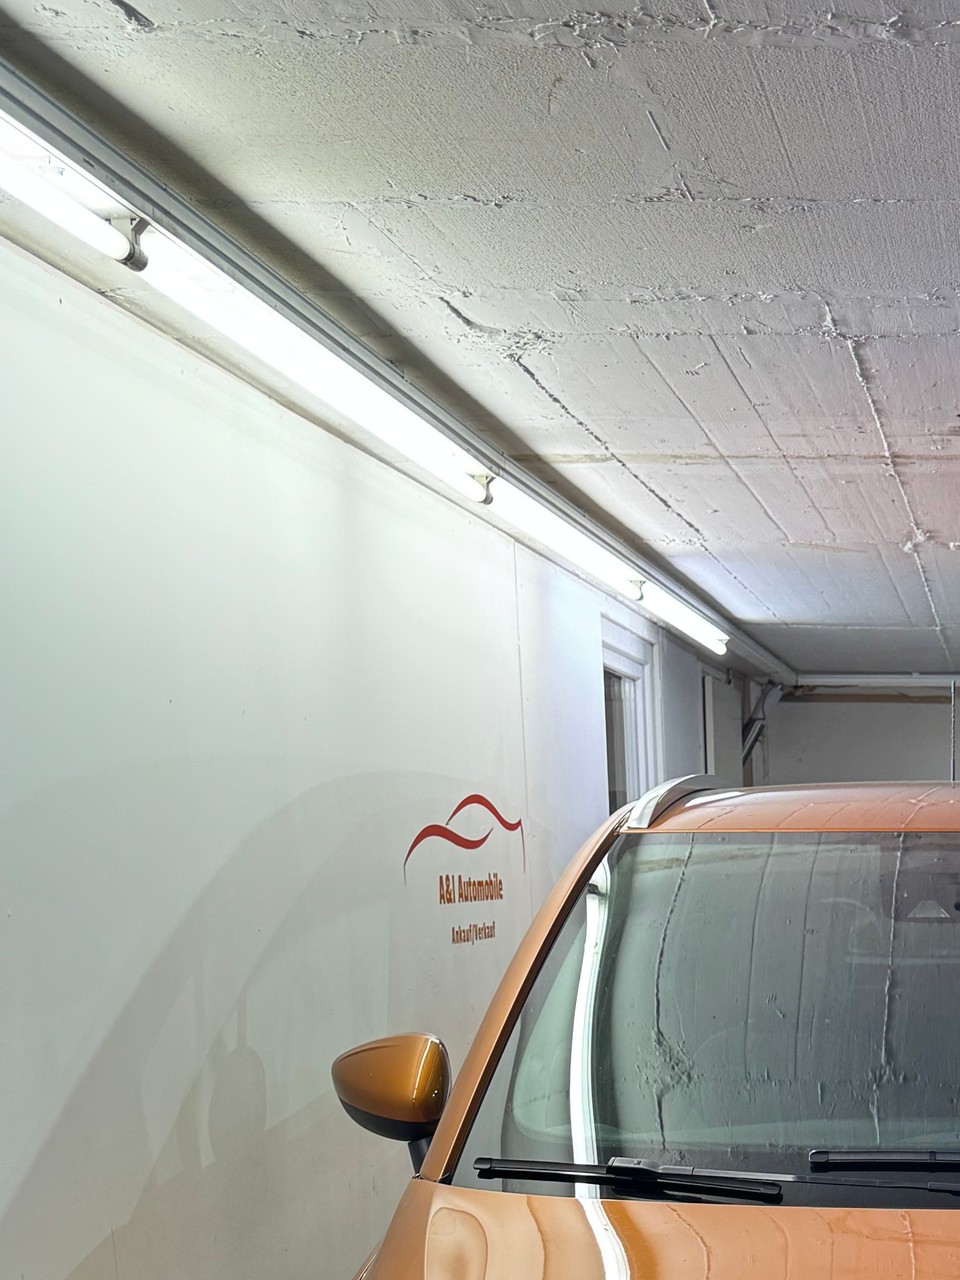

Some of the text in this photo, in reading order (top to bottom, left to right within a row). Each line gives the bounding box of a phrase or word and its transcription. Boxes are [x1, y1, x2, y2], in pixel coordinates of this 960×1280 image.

[439, 872, 504, 904] A&I Automobile
[451, 920, 496, 946] Ankauf/Verkauf
